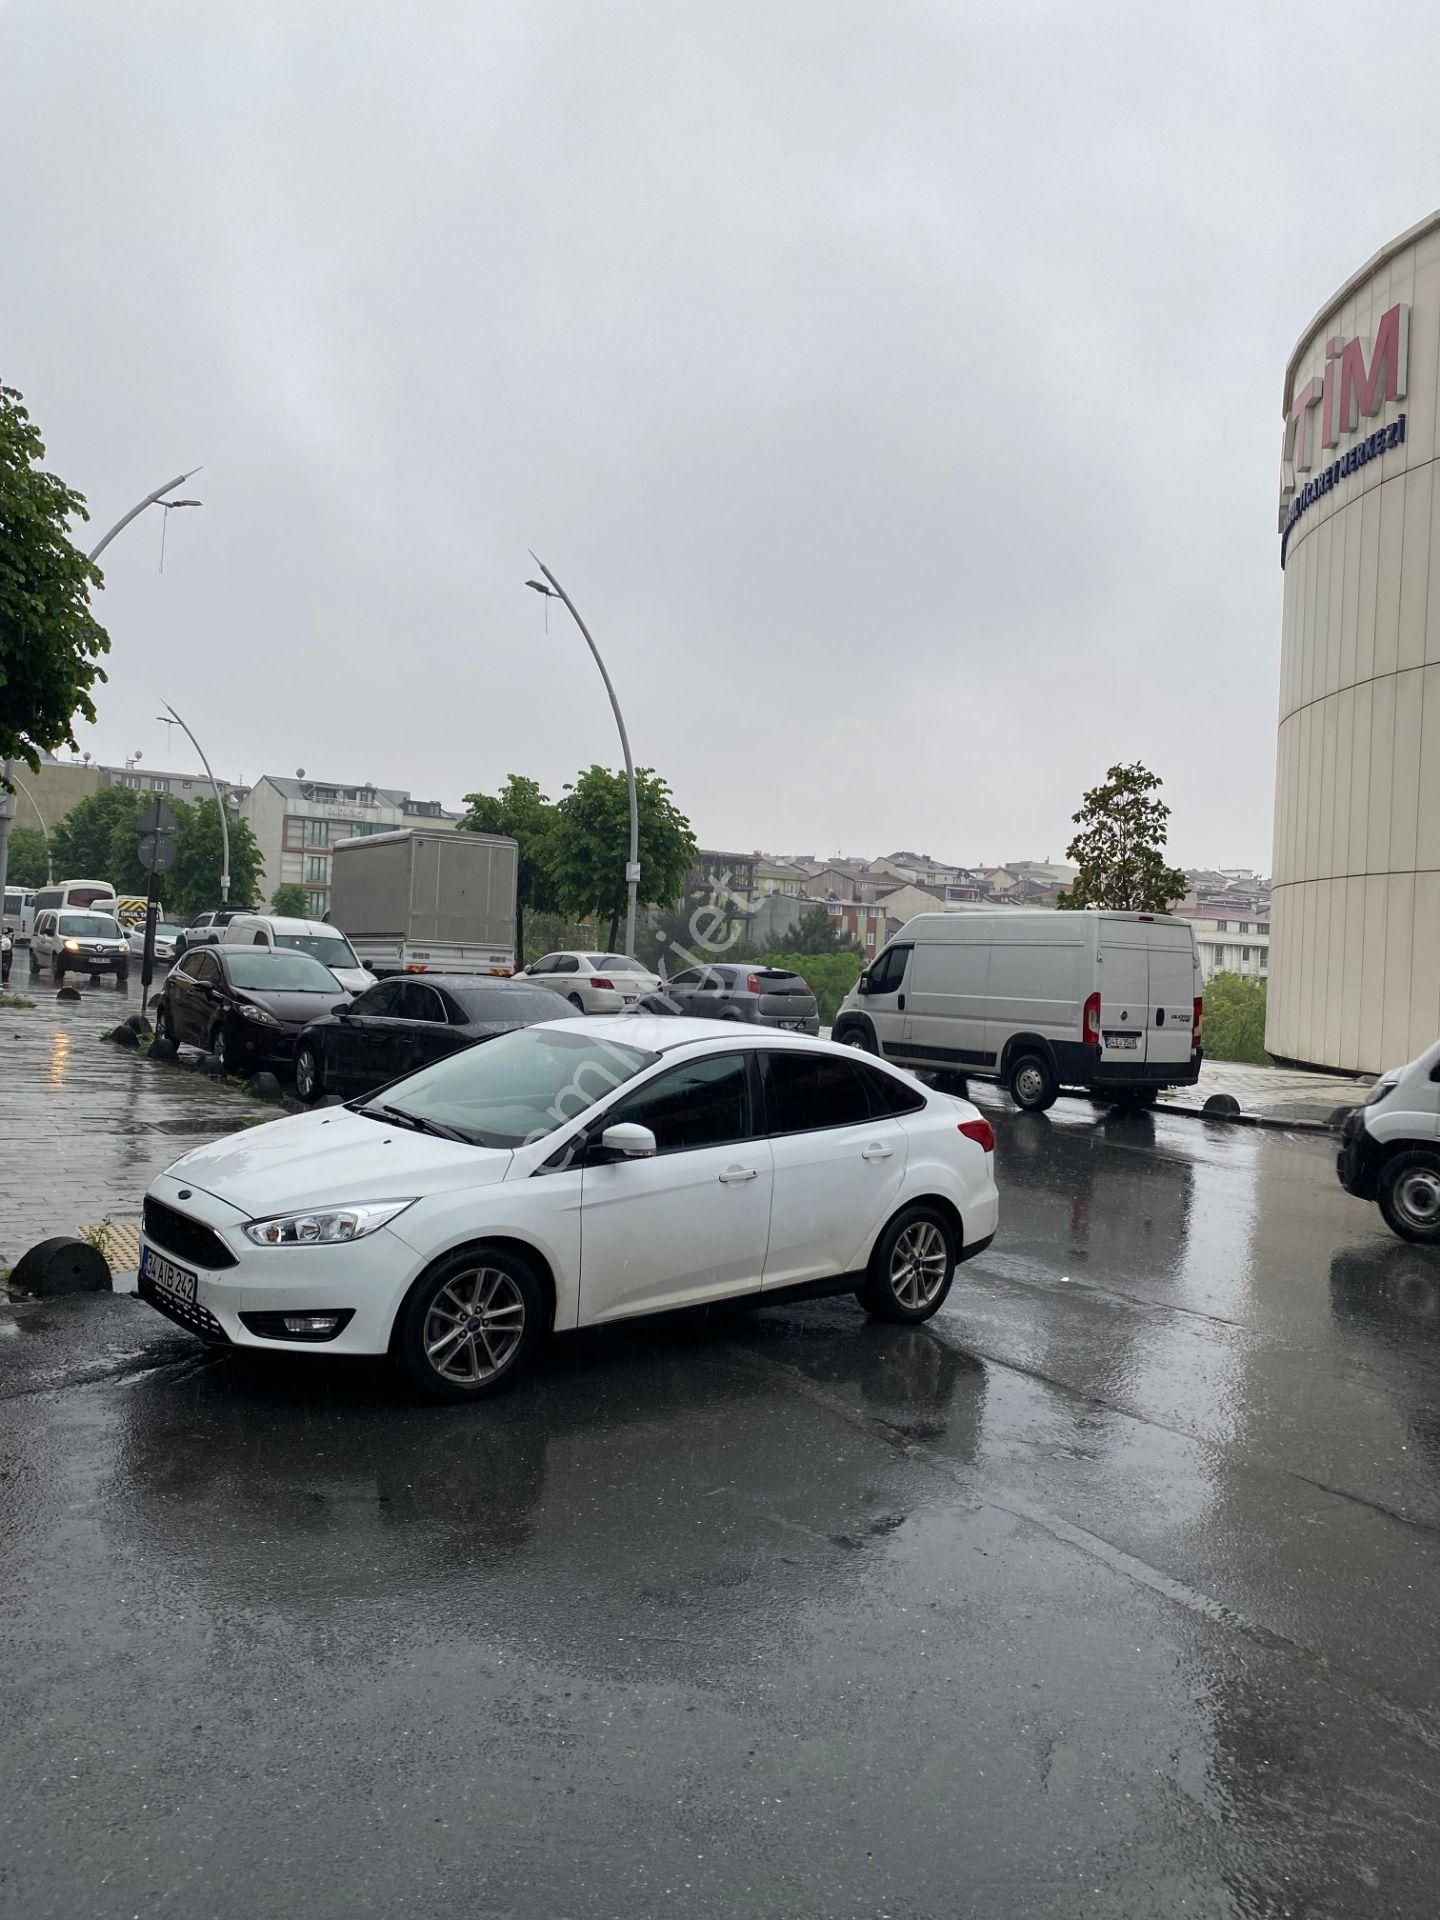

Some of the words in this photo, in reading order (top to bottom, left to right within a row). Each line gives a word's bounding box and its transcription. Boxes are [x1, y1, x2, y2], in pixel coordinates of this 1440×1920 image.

[1340, 413, 1406, 478] MERKEZİ
[157, 1260, 174, 1288] AIB
[175, 1271, 193, 1300] 242
